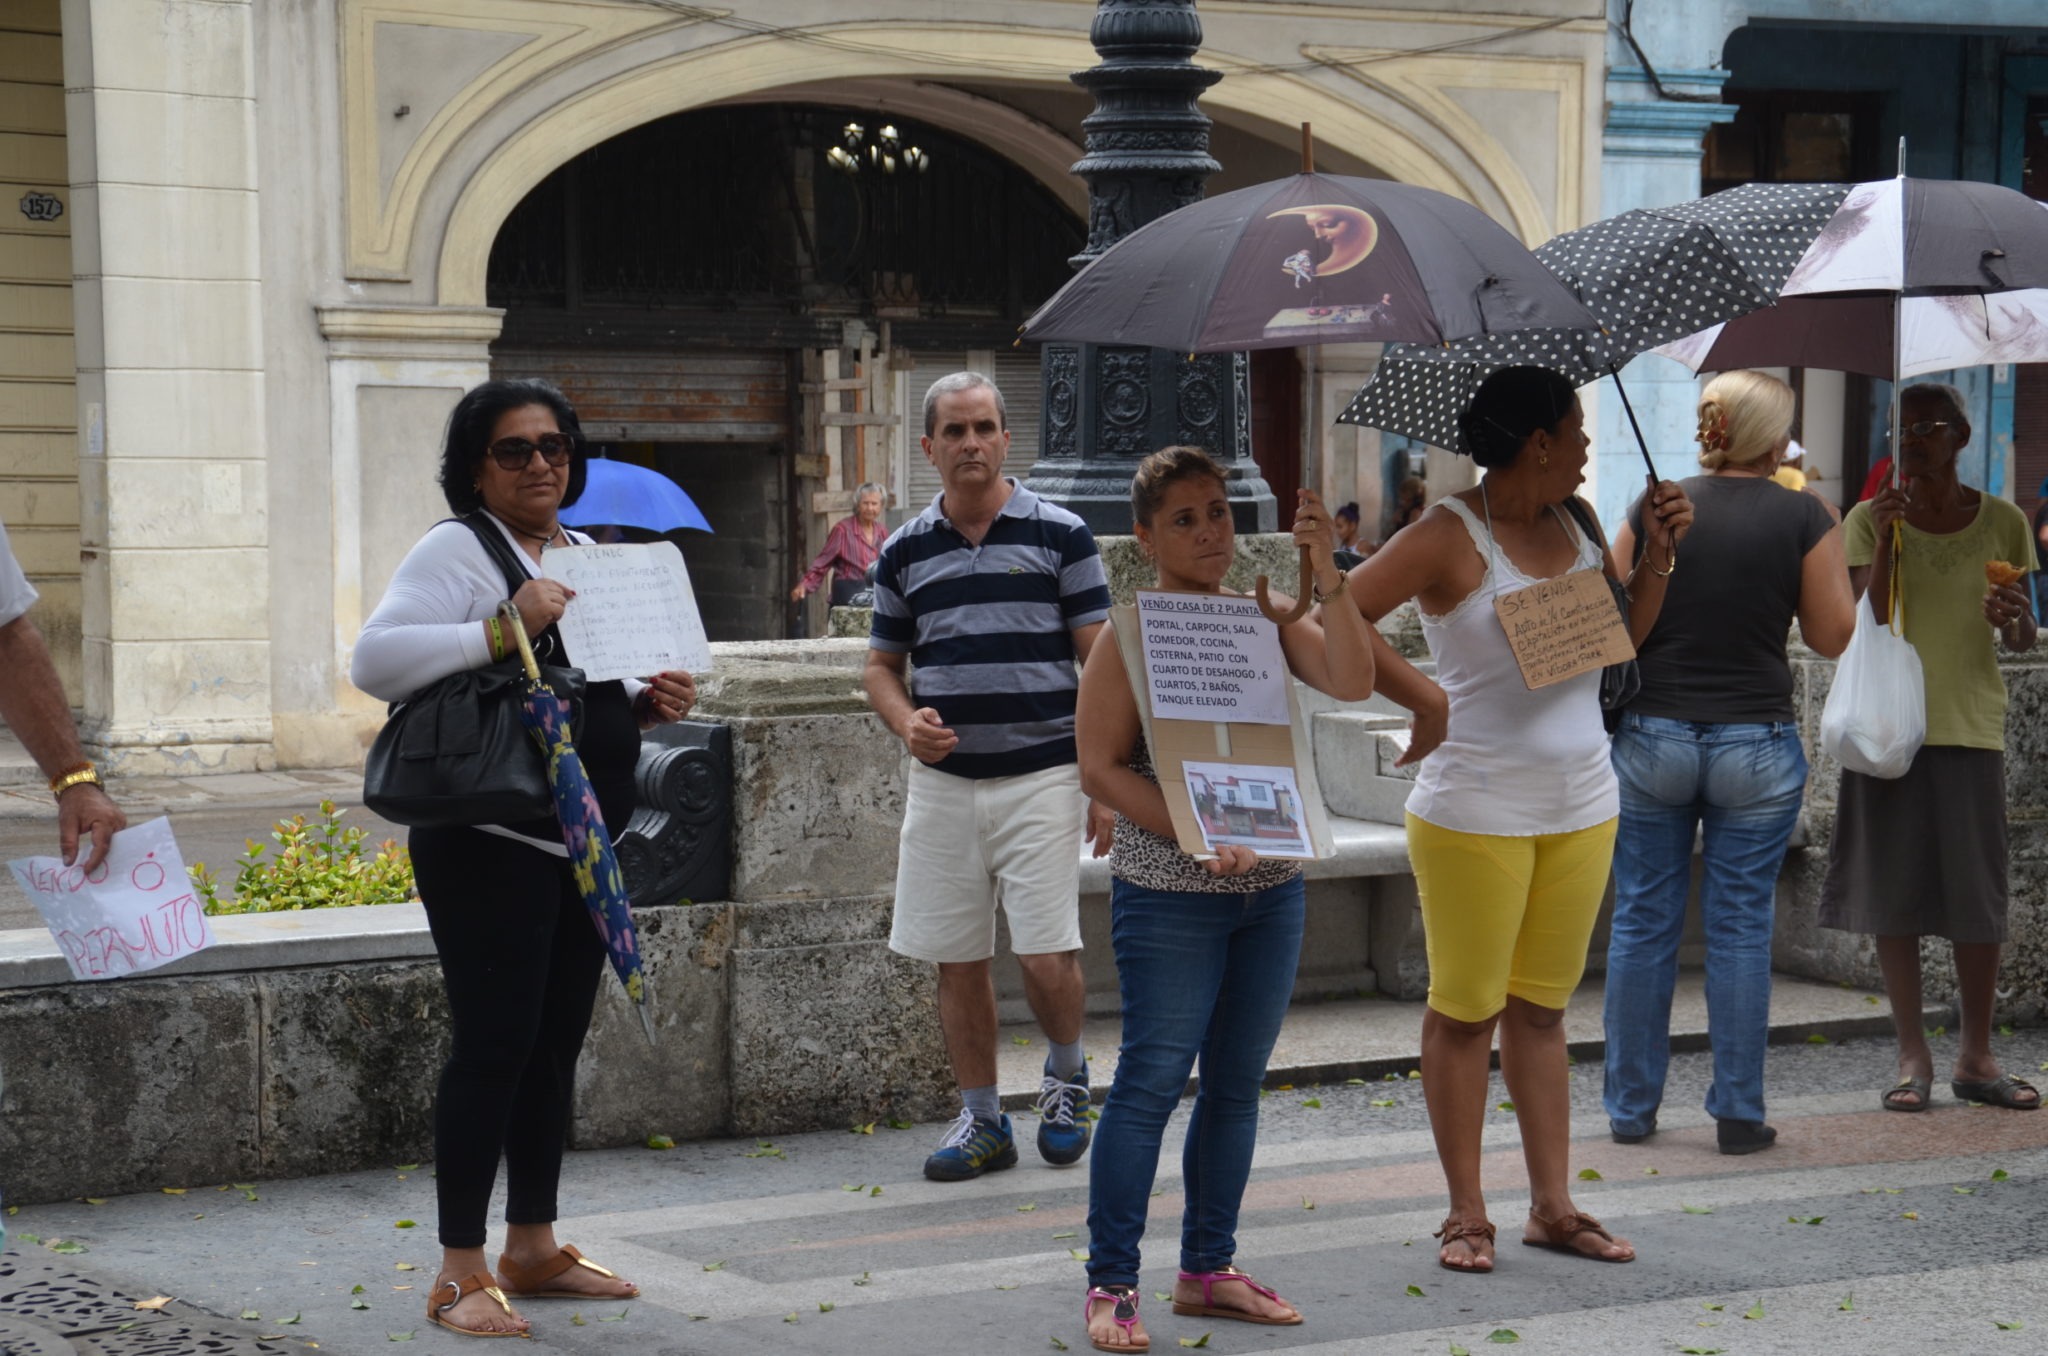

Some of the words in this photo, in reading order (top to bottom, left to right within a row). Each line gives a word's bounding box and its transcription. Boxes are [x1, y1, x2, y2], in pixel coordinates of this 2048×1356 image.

[29, 198, 54, 215] 157
[1503, 591, 1529, 616] SE
[1530, 579, 1575, 605] VENDE
[1140, 600, 1174, 611] VENDO
[1176, 601, 1201, 612] CASA
[1203, 603, 1215, 613] DE
[1217, 604, 1223, 613] 2
[1225, 605, 1263, 616] PLANTA
[1147, 619, 1184, 632] PORTAL,
[1185, 621, 1232, 635] CARPOCH,
[1233, 625, 1259, 637] SALA,
[1148, 634, 1199, 648] COMEDOR,
[1200, 638, 1238, 650] COCINA,
[1150, 649, 1197, 662] CISTERNA,
[1198, 652, 1225, 663] PATIO
[1228, 654, 1249, 664] CON
[1152, 664, 1190, 675] CUARTO
[1191, 666, 1204, 677] DE
[1205, 667, 1256, 679] DESAHOGO
[1262, 671, 1269, 680] 6
[1154, 679, 1200, 692] CUARTOS,
[1201, 682, 1207, 691] 2
[1209, 680, 1243, 694] BAÑOS,
[1156, 694, 1194, 706] TANQUE
[1196, 696, 1238, 707] ELEVADO
[58, 893, 205, 975] PERMUTO
